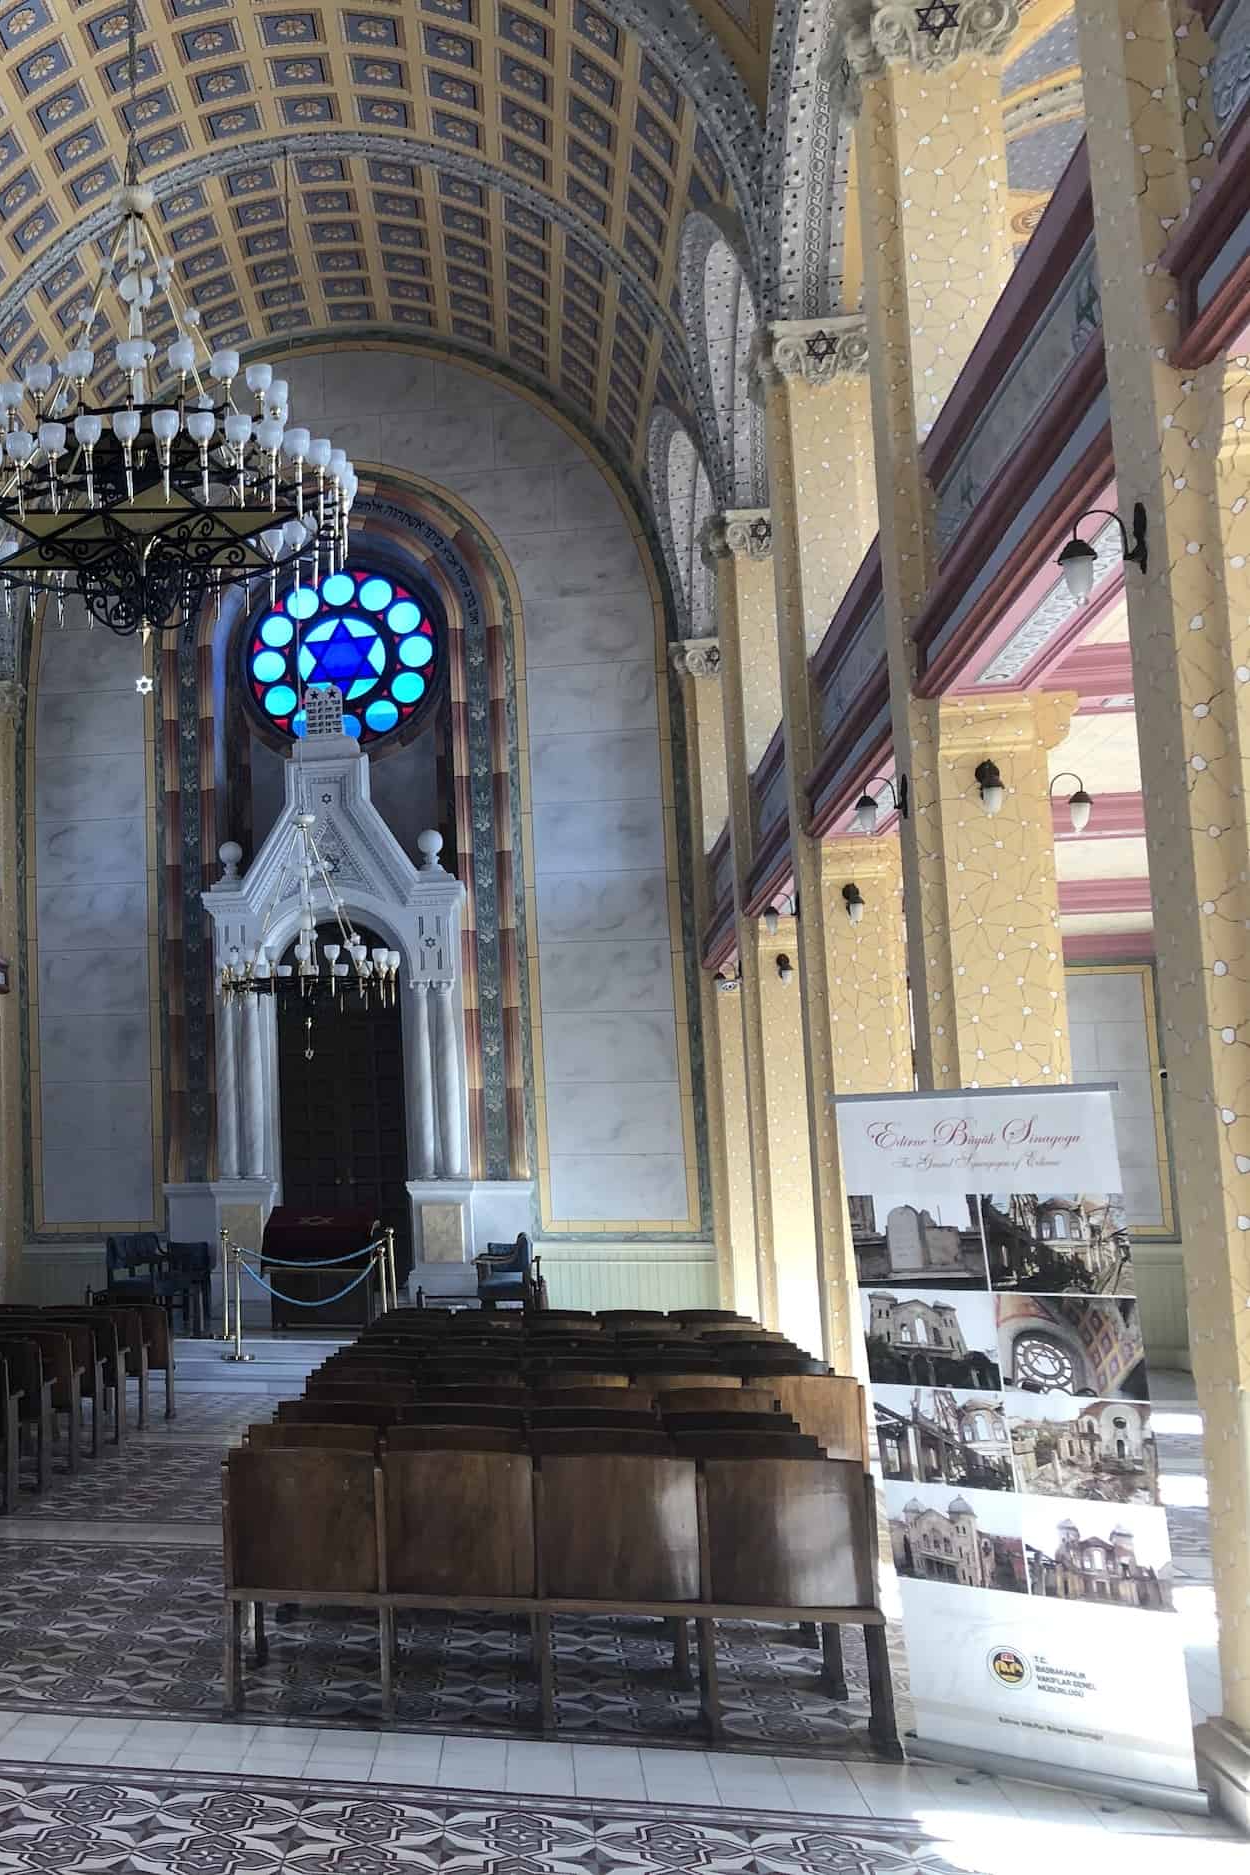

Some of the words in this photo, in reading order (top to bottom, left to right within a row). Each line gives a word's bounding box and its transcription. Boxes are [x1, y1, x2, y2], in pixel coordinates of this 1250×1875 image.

[866, 1121, 928, 1149] Edirne
[933, 1116, 996, 1150] Büyük
[1002, 1114, 1081, 1151] Sinagogu
